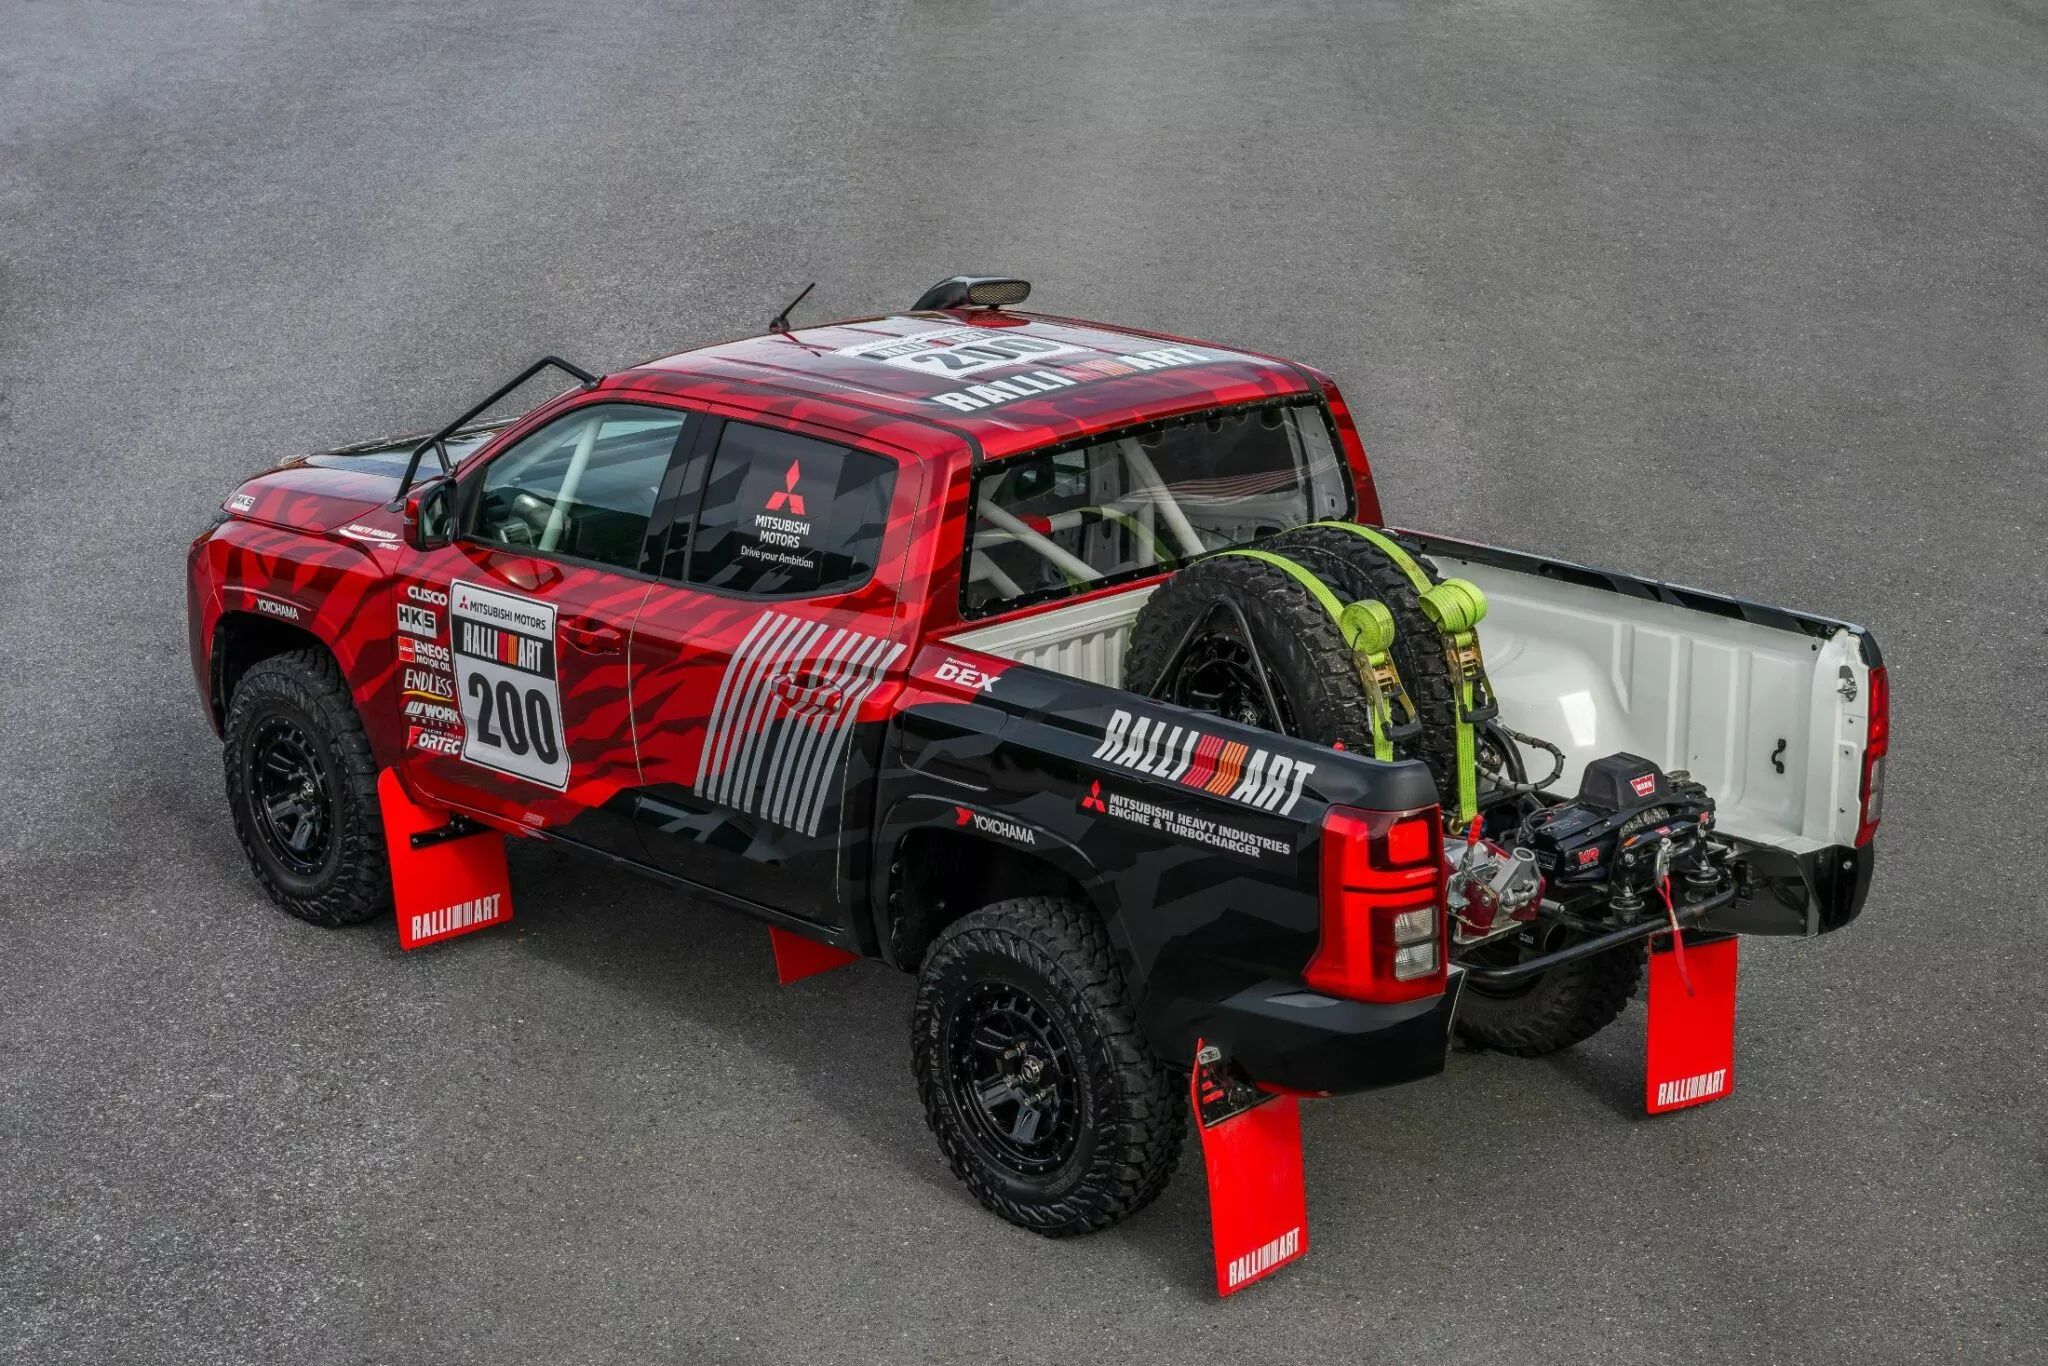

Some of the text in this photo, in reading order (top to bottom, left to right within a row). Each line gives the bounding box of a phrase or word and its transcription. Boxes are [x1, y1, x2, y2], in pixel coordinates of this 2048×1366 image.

[911, 338, 1061, 371] 200
[755, 514, 811, 535] MITSUBISHI
[759, 530, 800, 548] MOTORS
[741, 545, 814, 569] Drive your Ambition
[407, 585, 448, 606] CUSCO
[257, 598, 299, 620] YOKOHAMA
[398, 605, 435, 629] HKS
[470, 601, 546, 631] MITSUBISHI MOTORS
[414, 639, 450, 662] ENEOS
[416, 655, 452, 673] MOTOR OIL
[404, 668, 453, 698] ENDLESS
[934, 662, 1002, 693] DEX
[424, 703, 463, 726] WORK
[468, 672, 559, 765] 200
[973, 814, 1036, 845] YOKOHAMA
[1108, 803, 1261, 858] ENGINE & TURBOCHARGER
[1110, 793, 1291, 855] MITSUBISHI HEAVY INDUSTRIES
